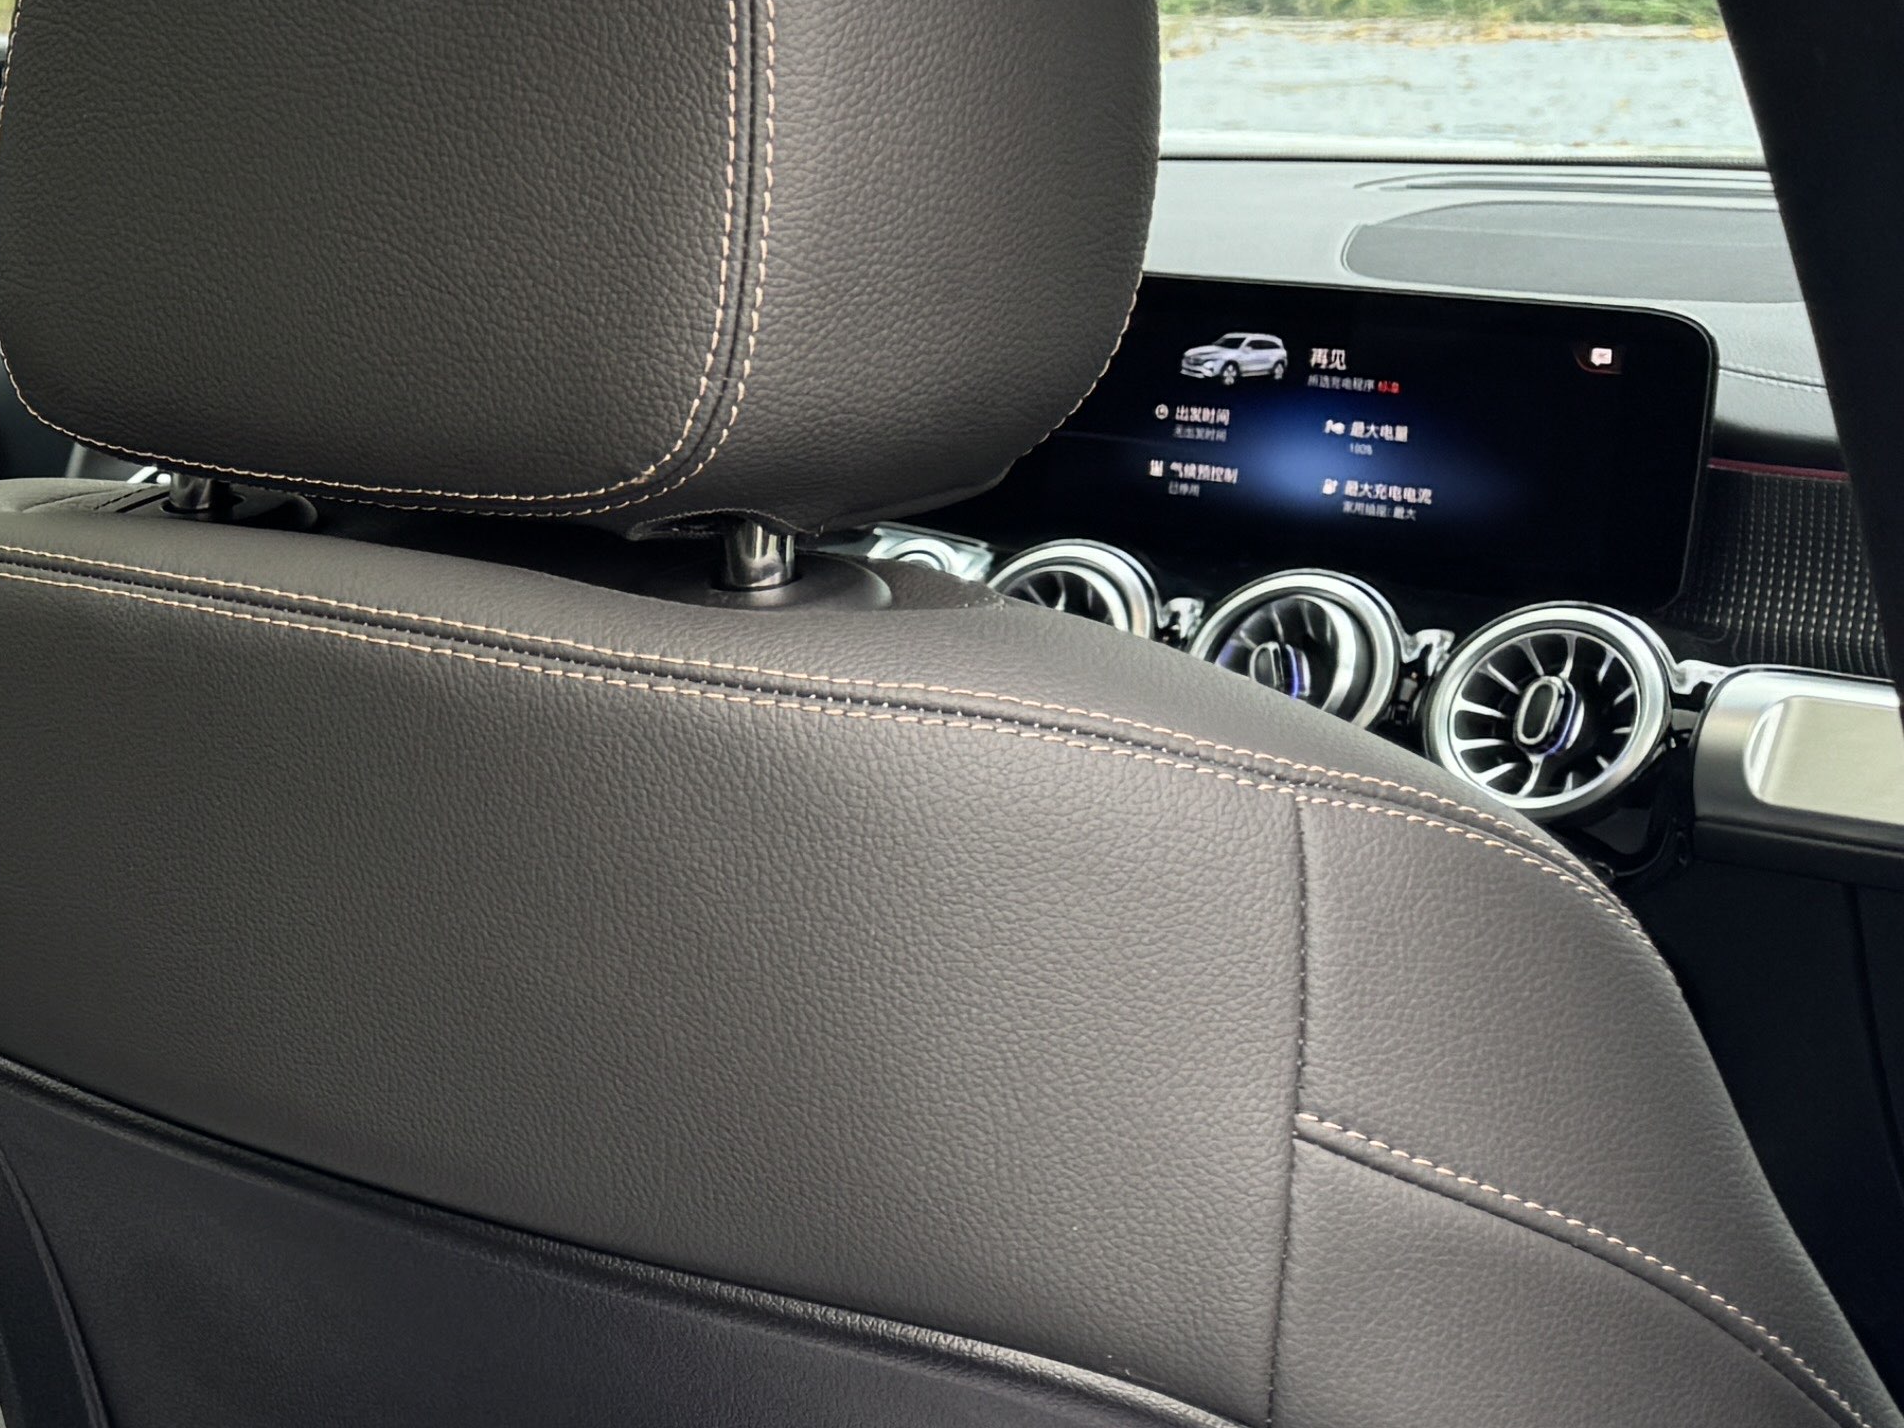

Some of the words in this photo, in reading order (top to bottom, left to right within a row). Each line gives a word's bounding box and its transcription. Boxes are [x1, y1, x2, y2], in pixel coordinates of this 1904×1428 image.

[1310, 348, 1346, 370] 再见
[1175, 405, 1230, 426] 出发时间
[1350, 421, 1408, 442] 最大电量
[1344, 480, 1432, 504] 最大充电电流
